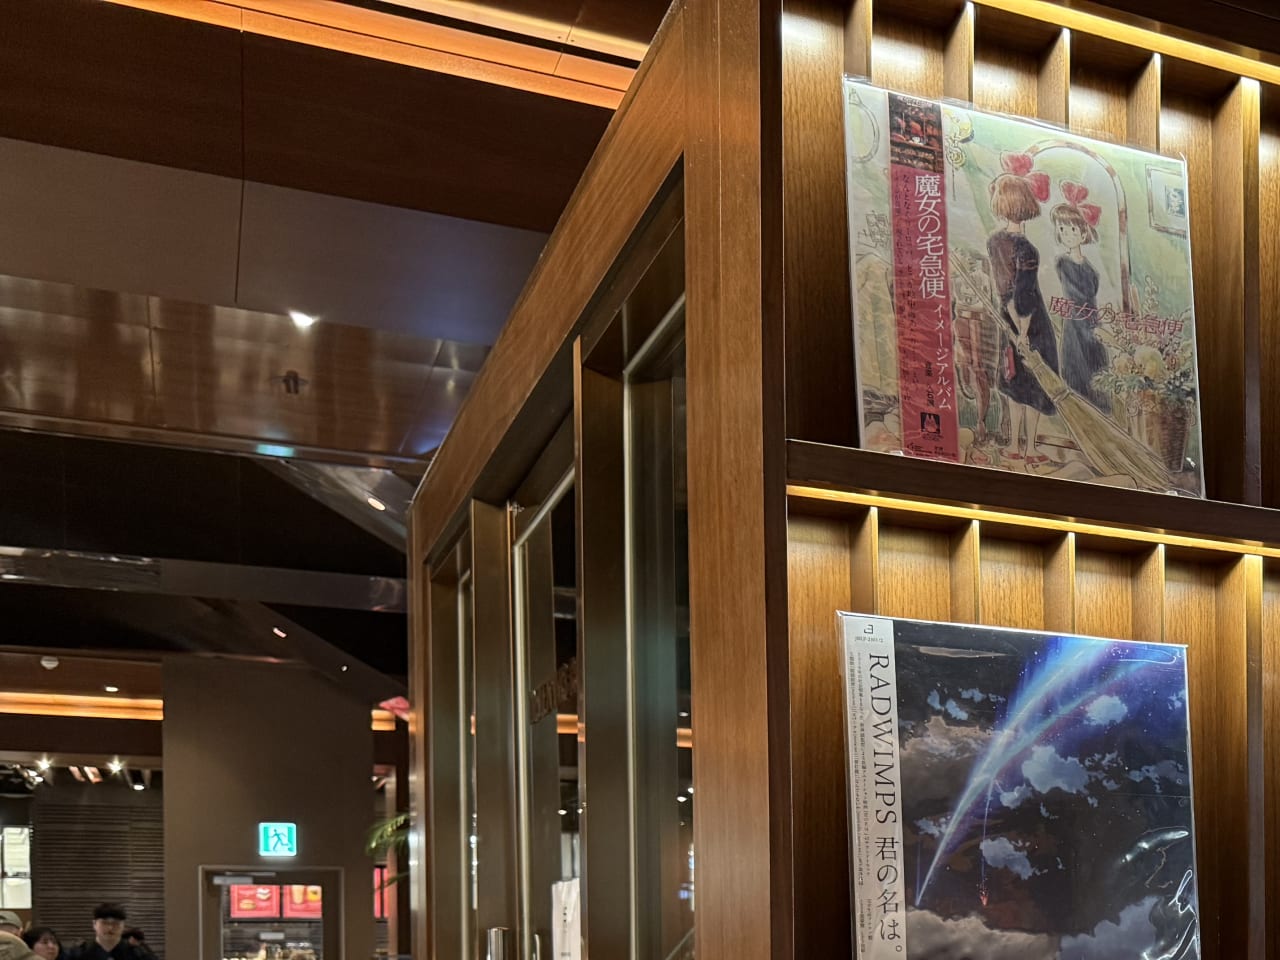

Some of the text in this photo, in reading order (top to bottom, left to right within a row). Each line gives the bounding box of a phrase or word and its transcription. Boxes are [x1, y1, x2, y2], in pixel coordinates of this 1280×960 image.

[914, 174, 947, 299] 魔女の宅急便
[934, 304, 951, 410] イメージアルバム
[1050, 296, 1184, 339] 魔女の宅急便
[869, 653, 897, 824] RADWIMPS
[874, 836, 902, 953] 君の名は。
